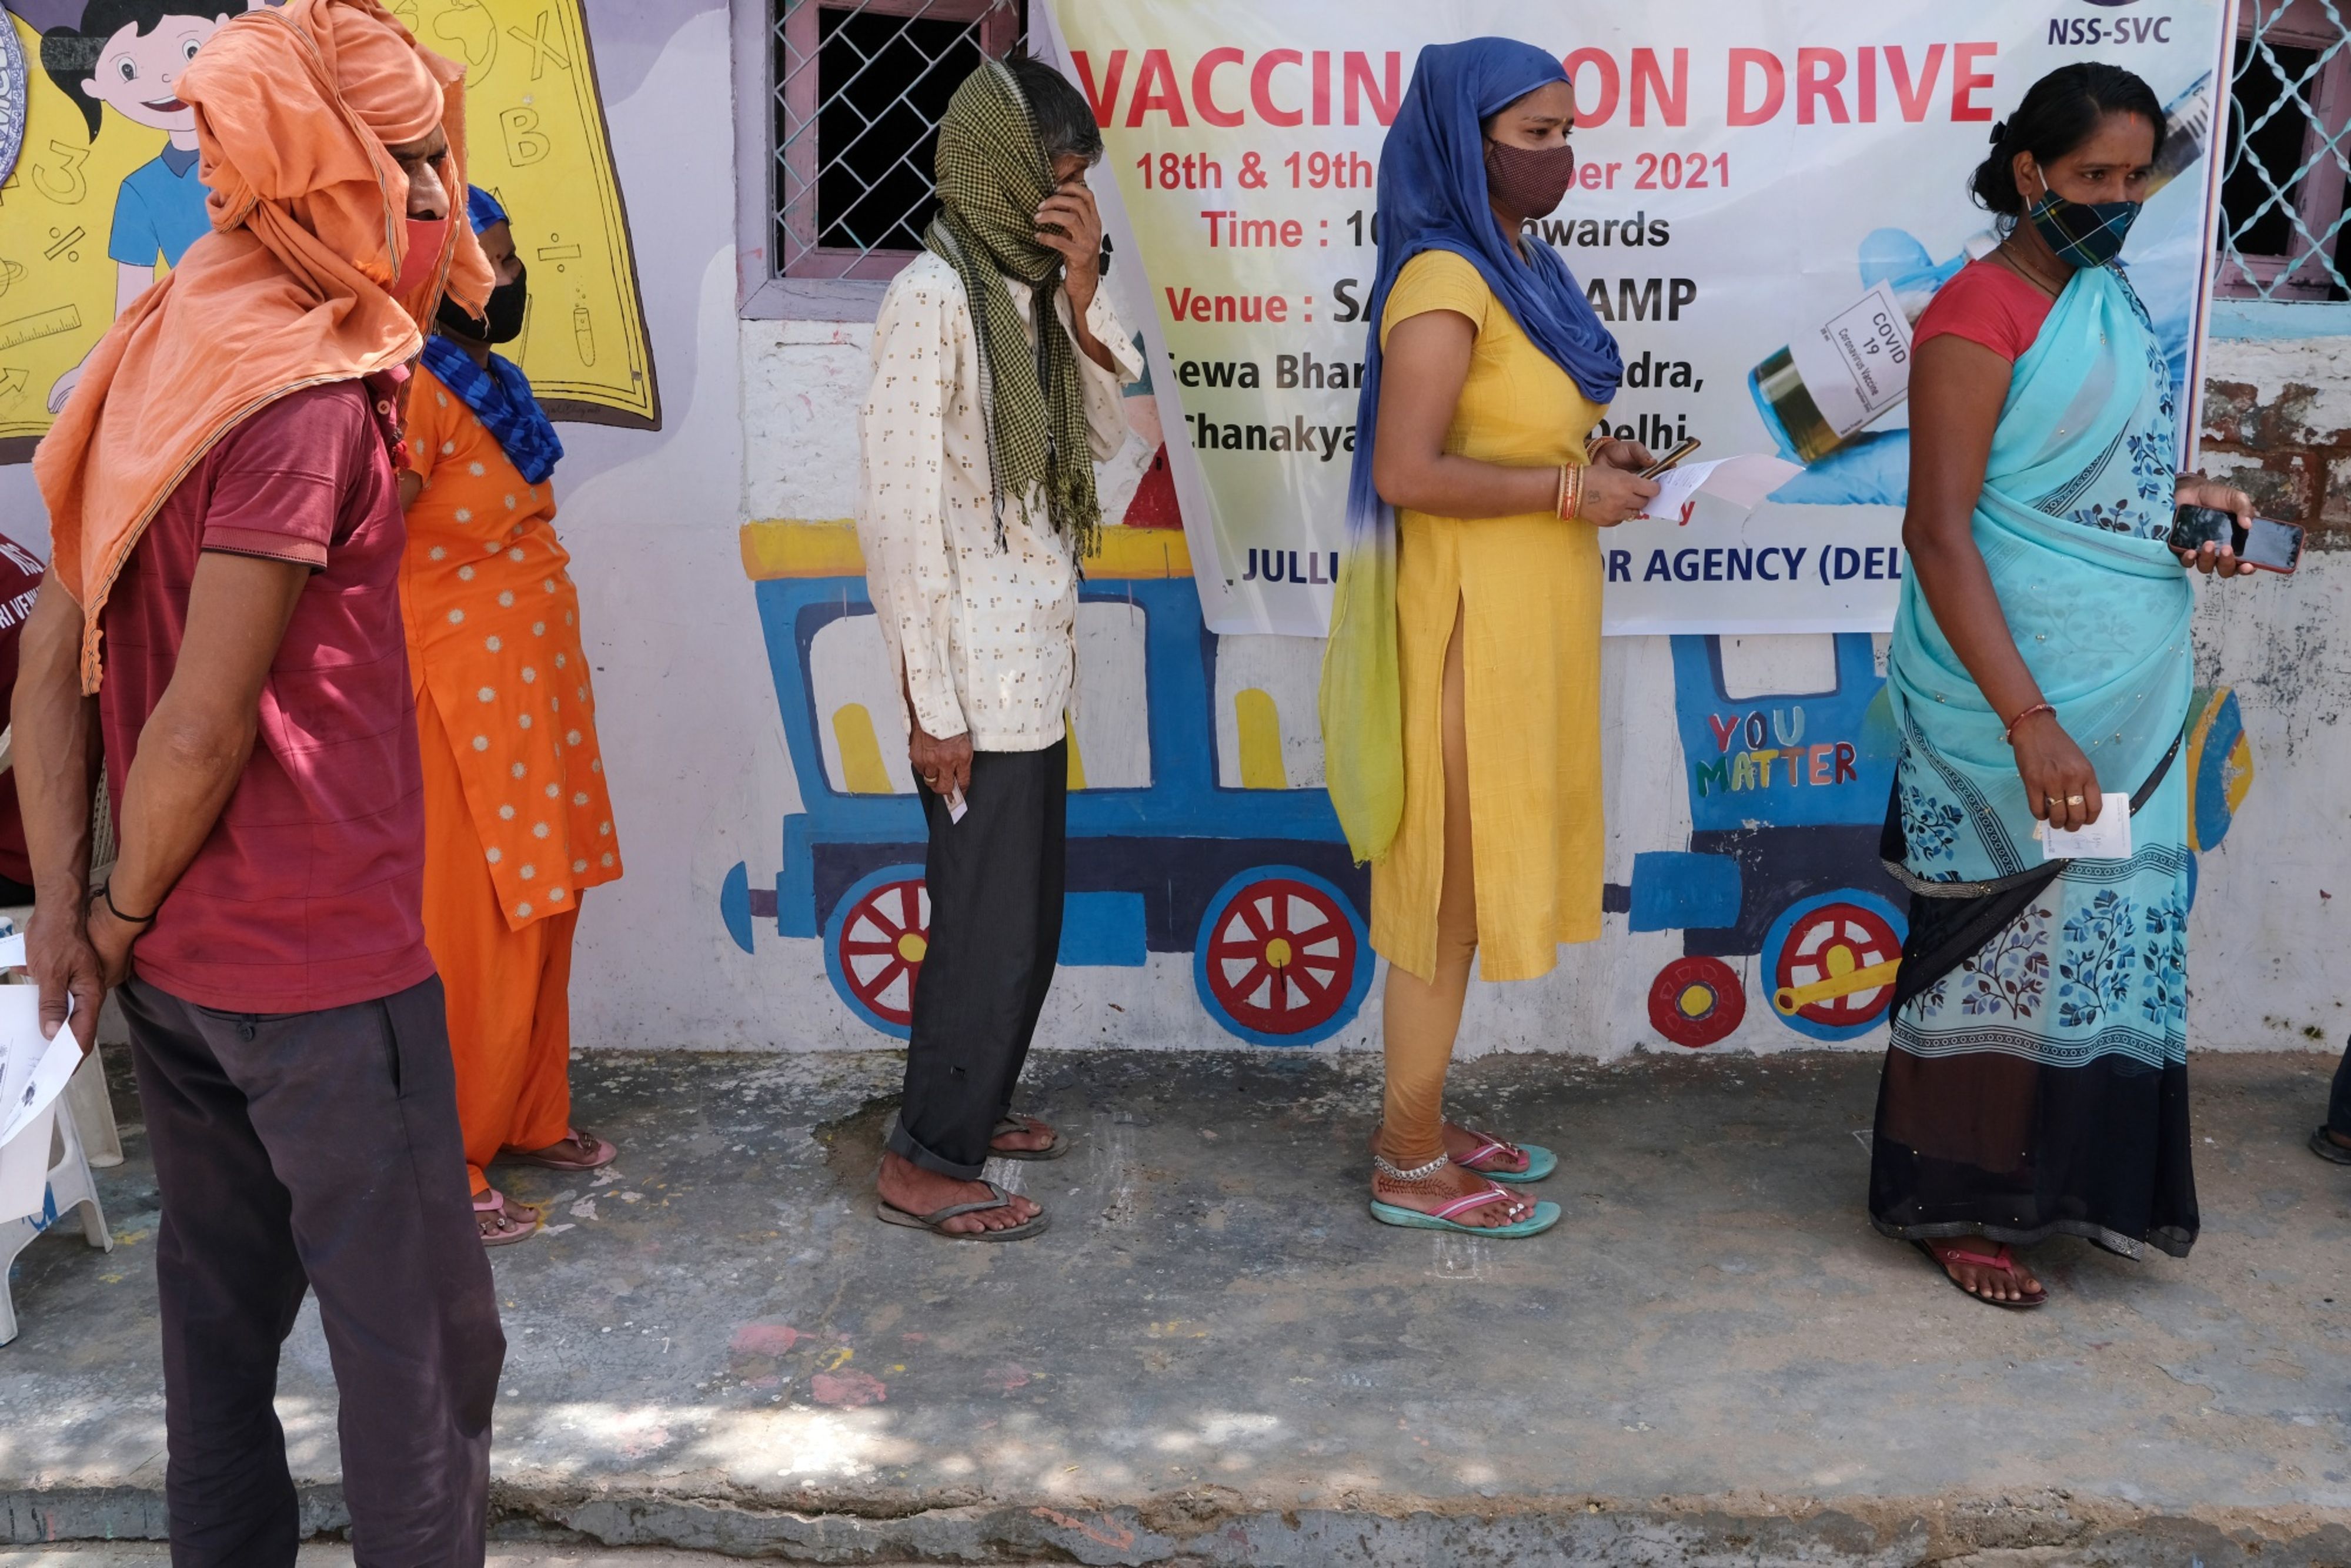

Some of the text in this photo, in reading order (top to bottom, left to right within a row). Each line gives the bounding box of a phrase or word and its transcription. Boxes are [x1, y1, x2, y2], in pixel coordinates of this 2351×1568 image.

[2048, 16, 2172, 45] NSS-SVC
[1726, 41, 1998, 127] DRIVE
[499, 107, 550, 167] B
[1136, 152, 1222, 190] 18th
[1237, 151, 1268, 189] &
[1284, 151, 1372, 189] 19th
[1634, 152, 1729, 190] 2021
[1200, 210, 1303, 248] Time
[1520, 210, 1670, 248] nwards
[1165, 287, 1288, 323] Venue
[1585, 278, 1698, 322] AMP
[1862, 337, 1880, 356] 19
[1872, 312, 1906, 365] COVID
[1615, 350, 1704, 393] dra,
[1838, 327, 1879, 397] Coronavirus Vaccine
[1243, 548, 1338, 584] JULL
[1643, 547, 1808, 582] AGENCY
[1819, 544, 1901, 586] (DEL
[1708, 706, 1805, 753] YOU
[1695, 741, 1858, 798] MATTER
